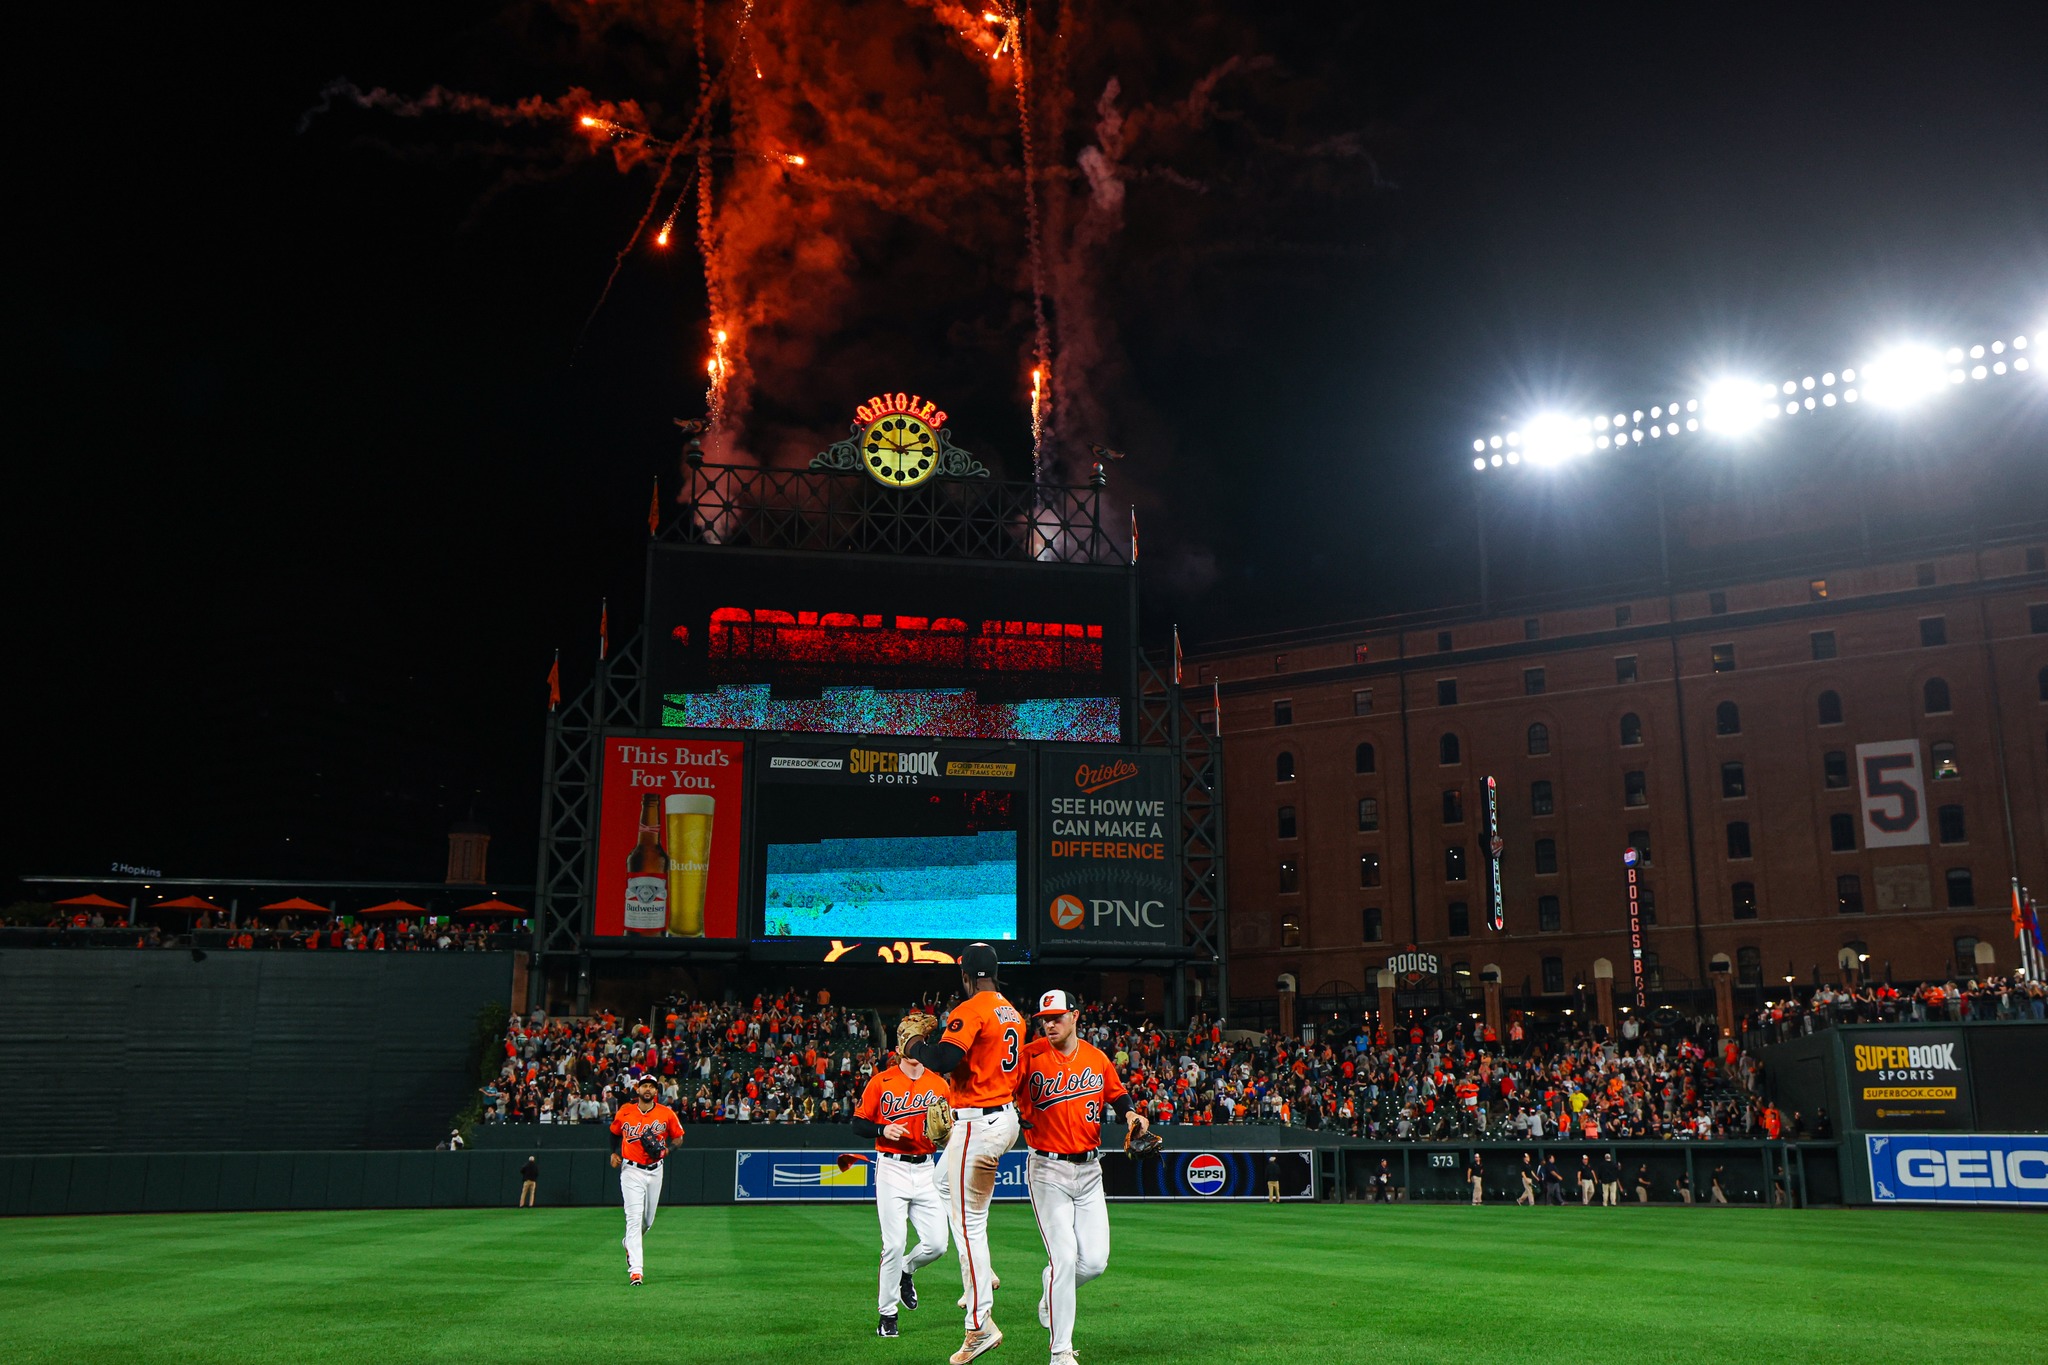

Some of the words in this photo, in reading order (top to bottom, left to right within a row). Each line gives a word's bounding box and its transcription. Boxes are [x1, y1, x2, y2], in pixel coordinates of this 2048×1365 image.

[856, 392, 949, 428] ORIOLES
[618, 745, 668, 765] This
[674, 747, 730, 767] Bud's
[772, 758, 841, 768] SUPERBOOK.COM
[850, 748, 939, 777] SUPERBOOK
[630, 768, 666, 787] For
[670, 770, 716, 789] You.
[869, 773, 918, 785] SPORTS
[1075, 759, 1138, 788] Orioles
[1863, 752, 1920, 833] 5
[1051, 798, 1086, 815] SEE
[1090, 799, 1133, 816] HOW
[1135, 800, 1165, 817] WE
[1052, 819, 1090, 837] CAN
[1094, 820, 1146, 838] MAKE
[1149, 822, 1163, 839] A
[1051, 840, 1165, 860] DIFFERENCE
[111, 862, 119, 872] 2
[120, 864, 162, 878] Hopkins
[626, 903, 665, 912] Budweiser
[1089, 899, 1165, 928] PNC
[1388, 953, 1438, 974] BOOG'S
[951, 1021, 960, 1030] 5
[1001, 1027, 1019, 1072] 3
[1855, 1043, 1957, 1072] SUPERBOOK
[1029, 1067, 1104, 1103] Orioles
[1879, 1070, 1935, 1081] SPORTS
[880, 1089, 942, 1116] Oriole
[1866, 1088, 1953, 1098] SUPERBOOK.COM
[1432, 1155, 1454, 1167] 373
[1896, 1149, 2048, 1189] GEIC
[1189, 1170, 1223, 1179] PEPSI
